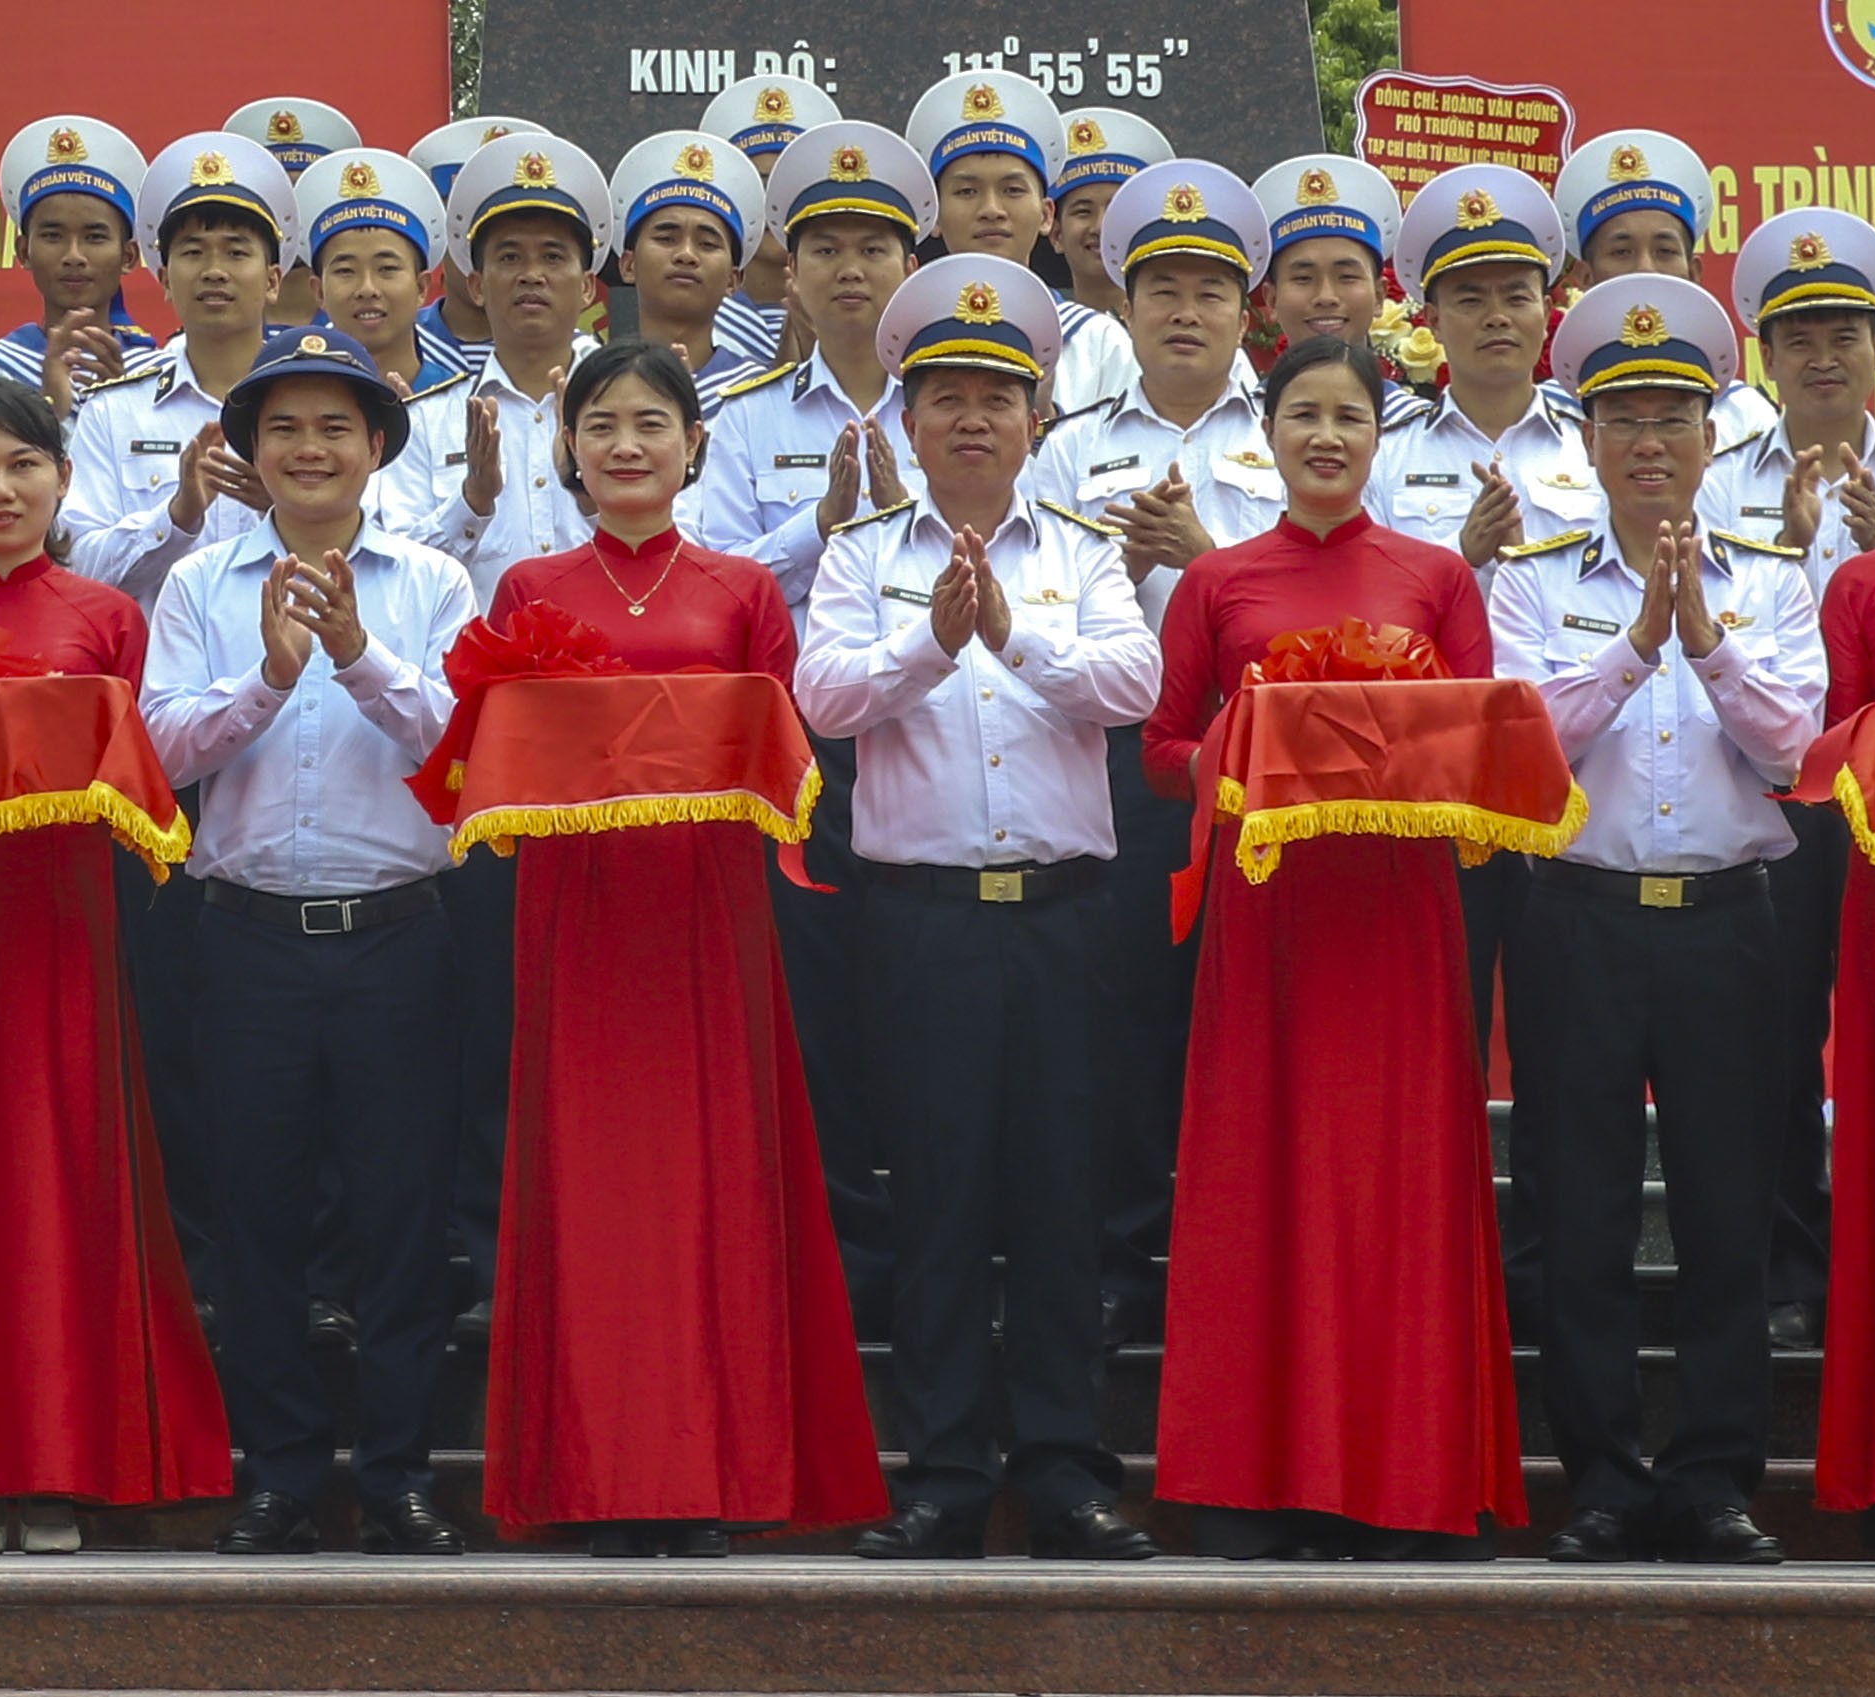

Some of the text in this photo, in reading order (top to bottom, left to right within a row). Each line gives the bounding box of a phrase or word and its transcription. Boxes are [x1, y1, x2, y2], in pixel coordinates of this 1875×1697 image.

[629, 48, 736, 94] KINH
[1441, 91, 1485, 116] HOÀNG
[980, 129, 1005, 146] VIỆT
[1395, 112, 1422, 134] PHÓ
[1477, 122, 1504, 142] BAN
[1505, 124, 1541, 147] ANQP
[1091, 158, 1116, 176] VIỆT
[67, 169, 92, 187] VIỆT
[685, 184, 712, 203] VIỆT
[1634, 185, 1659, 202] VIỆT
[357, 204, 384, 221] VIỆT
[1318, 211, 1344, 230] VIỆT
